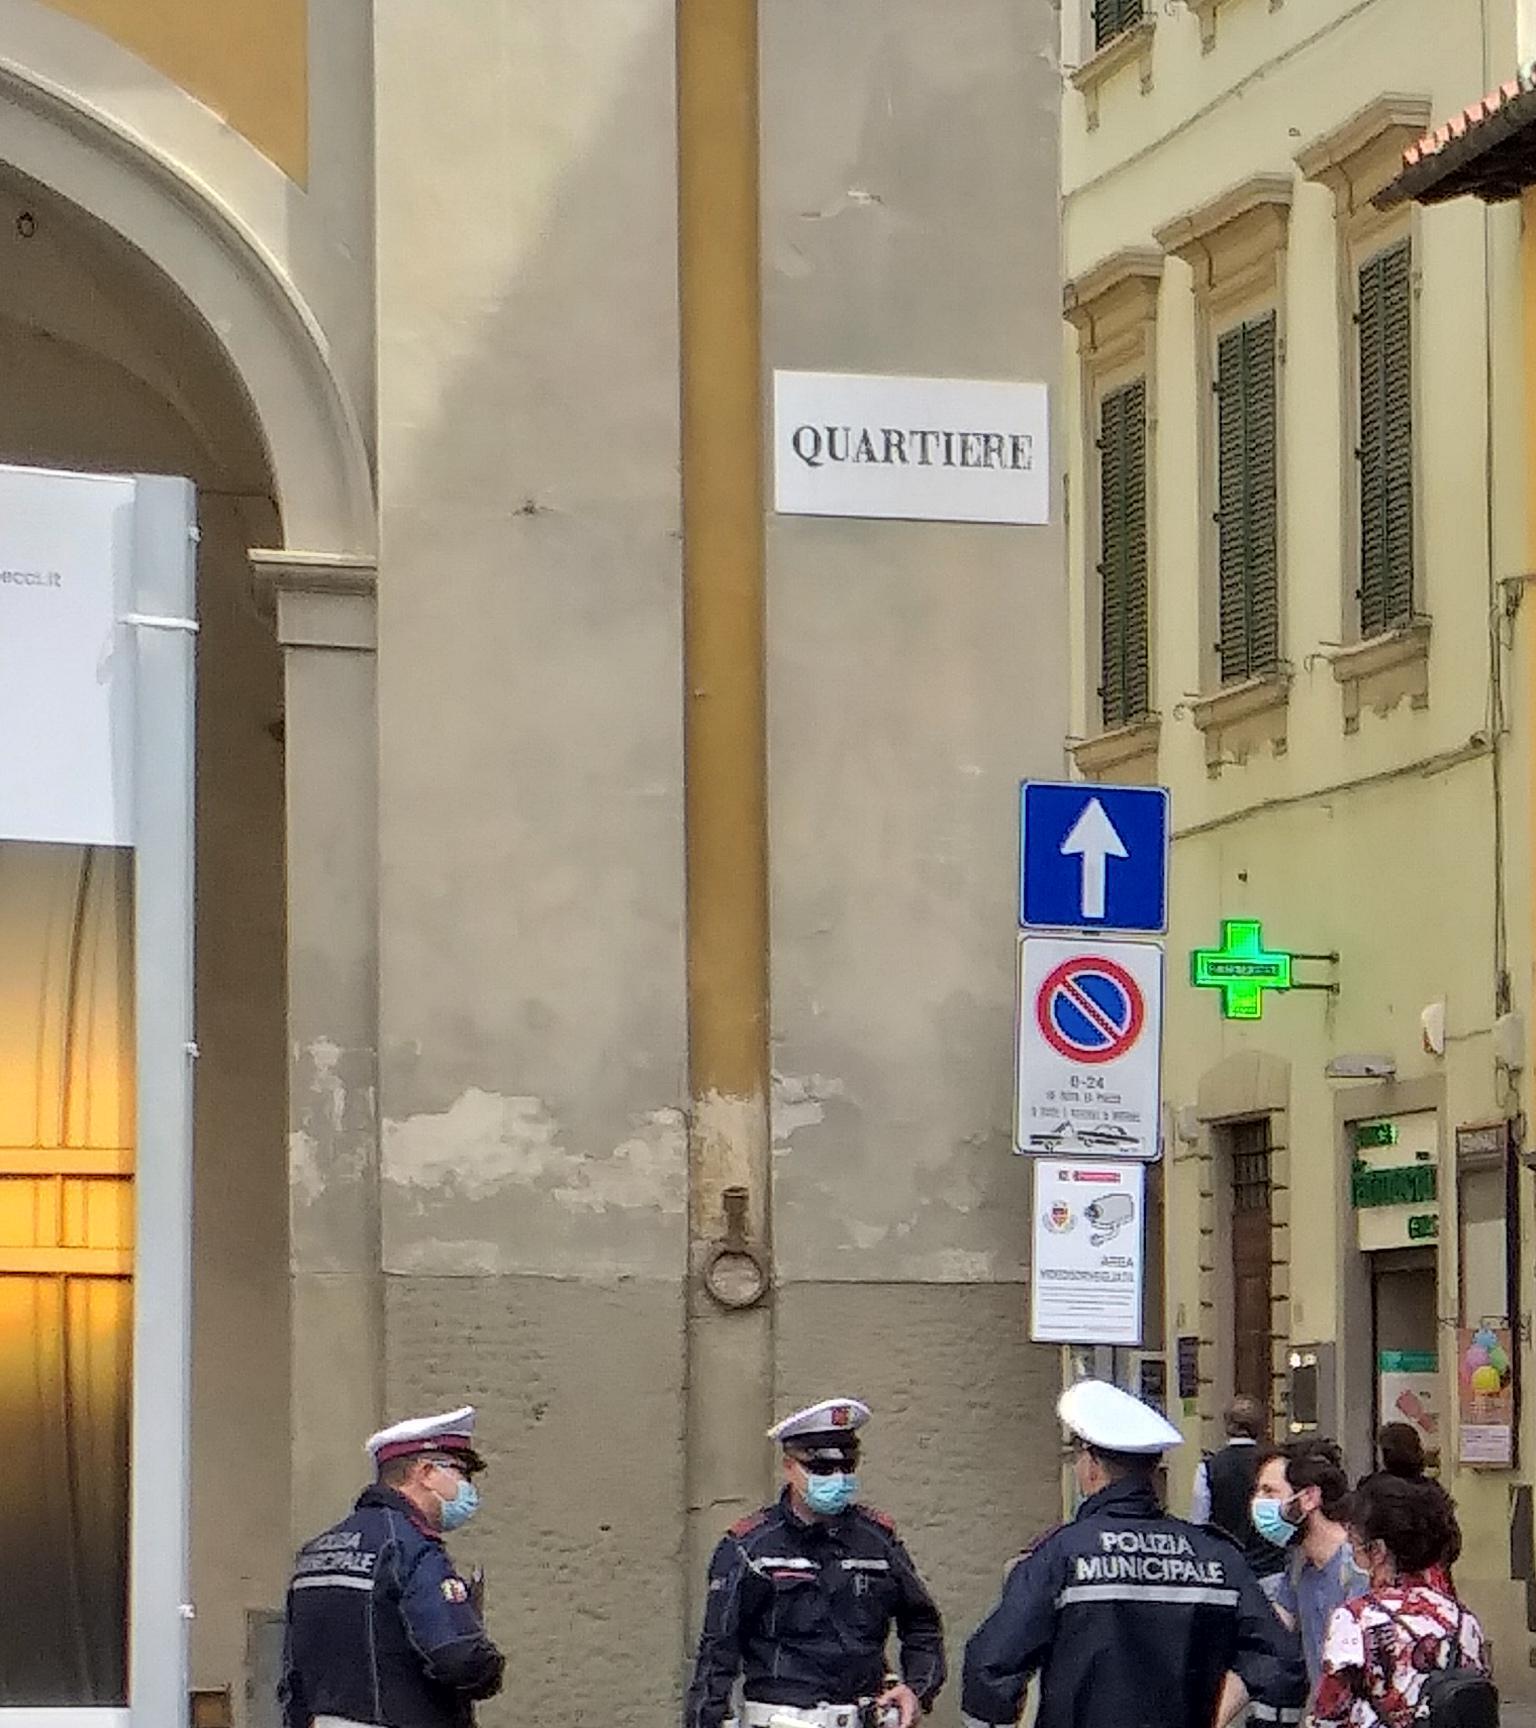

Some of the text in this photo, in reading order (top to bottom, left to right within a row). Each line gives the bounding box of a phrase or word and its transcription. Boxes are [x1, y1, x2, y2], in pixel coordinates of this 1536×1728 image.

[791, 425, 1034, 471] QUARTIERE
[1101, 1531, 1195, 1557] POLIZIA
[1076, 1556, 1225, 1584] MUNICIPALE
